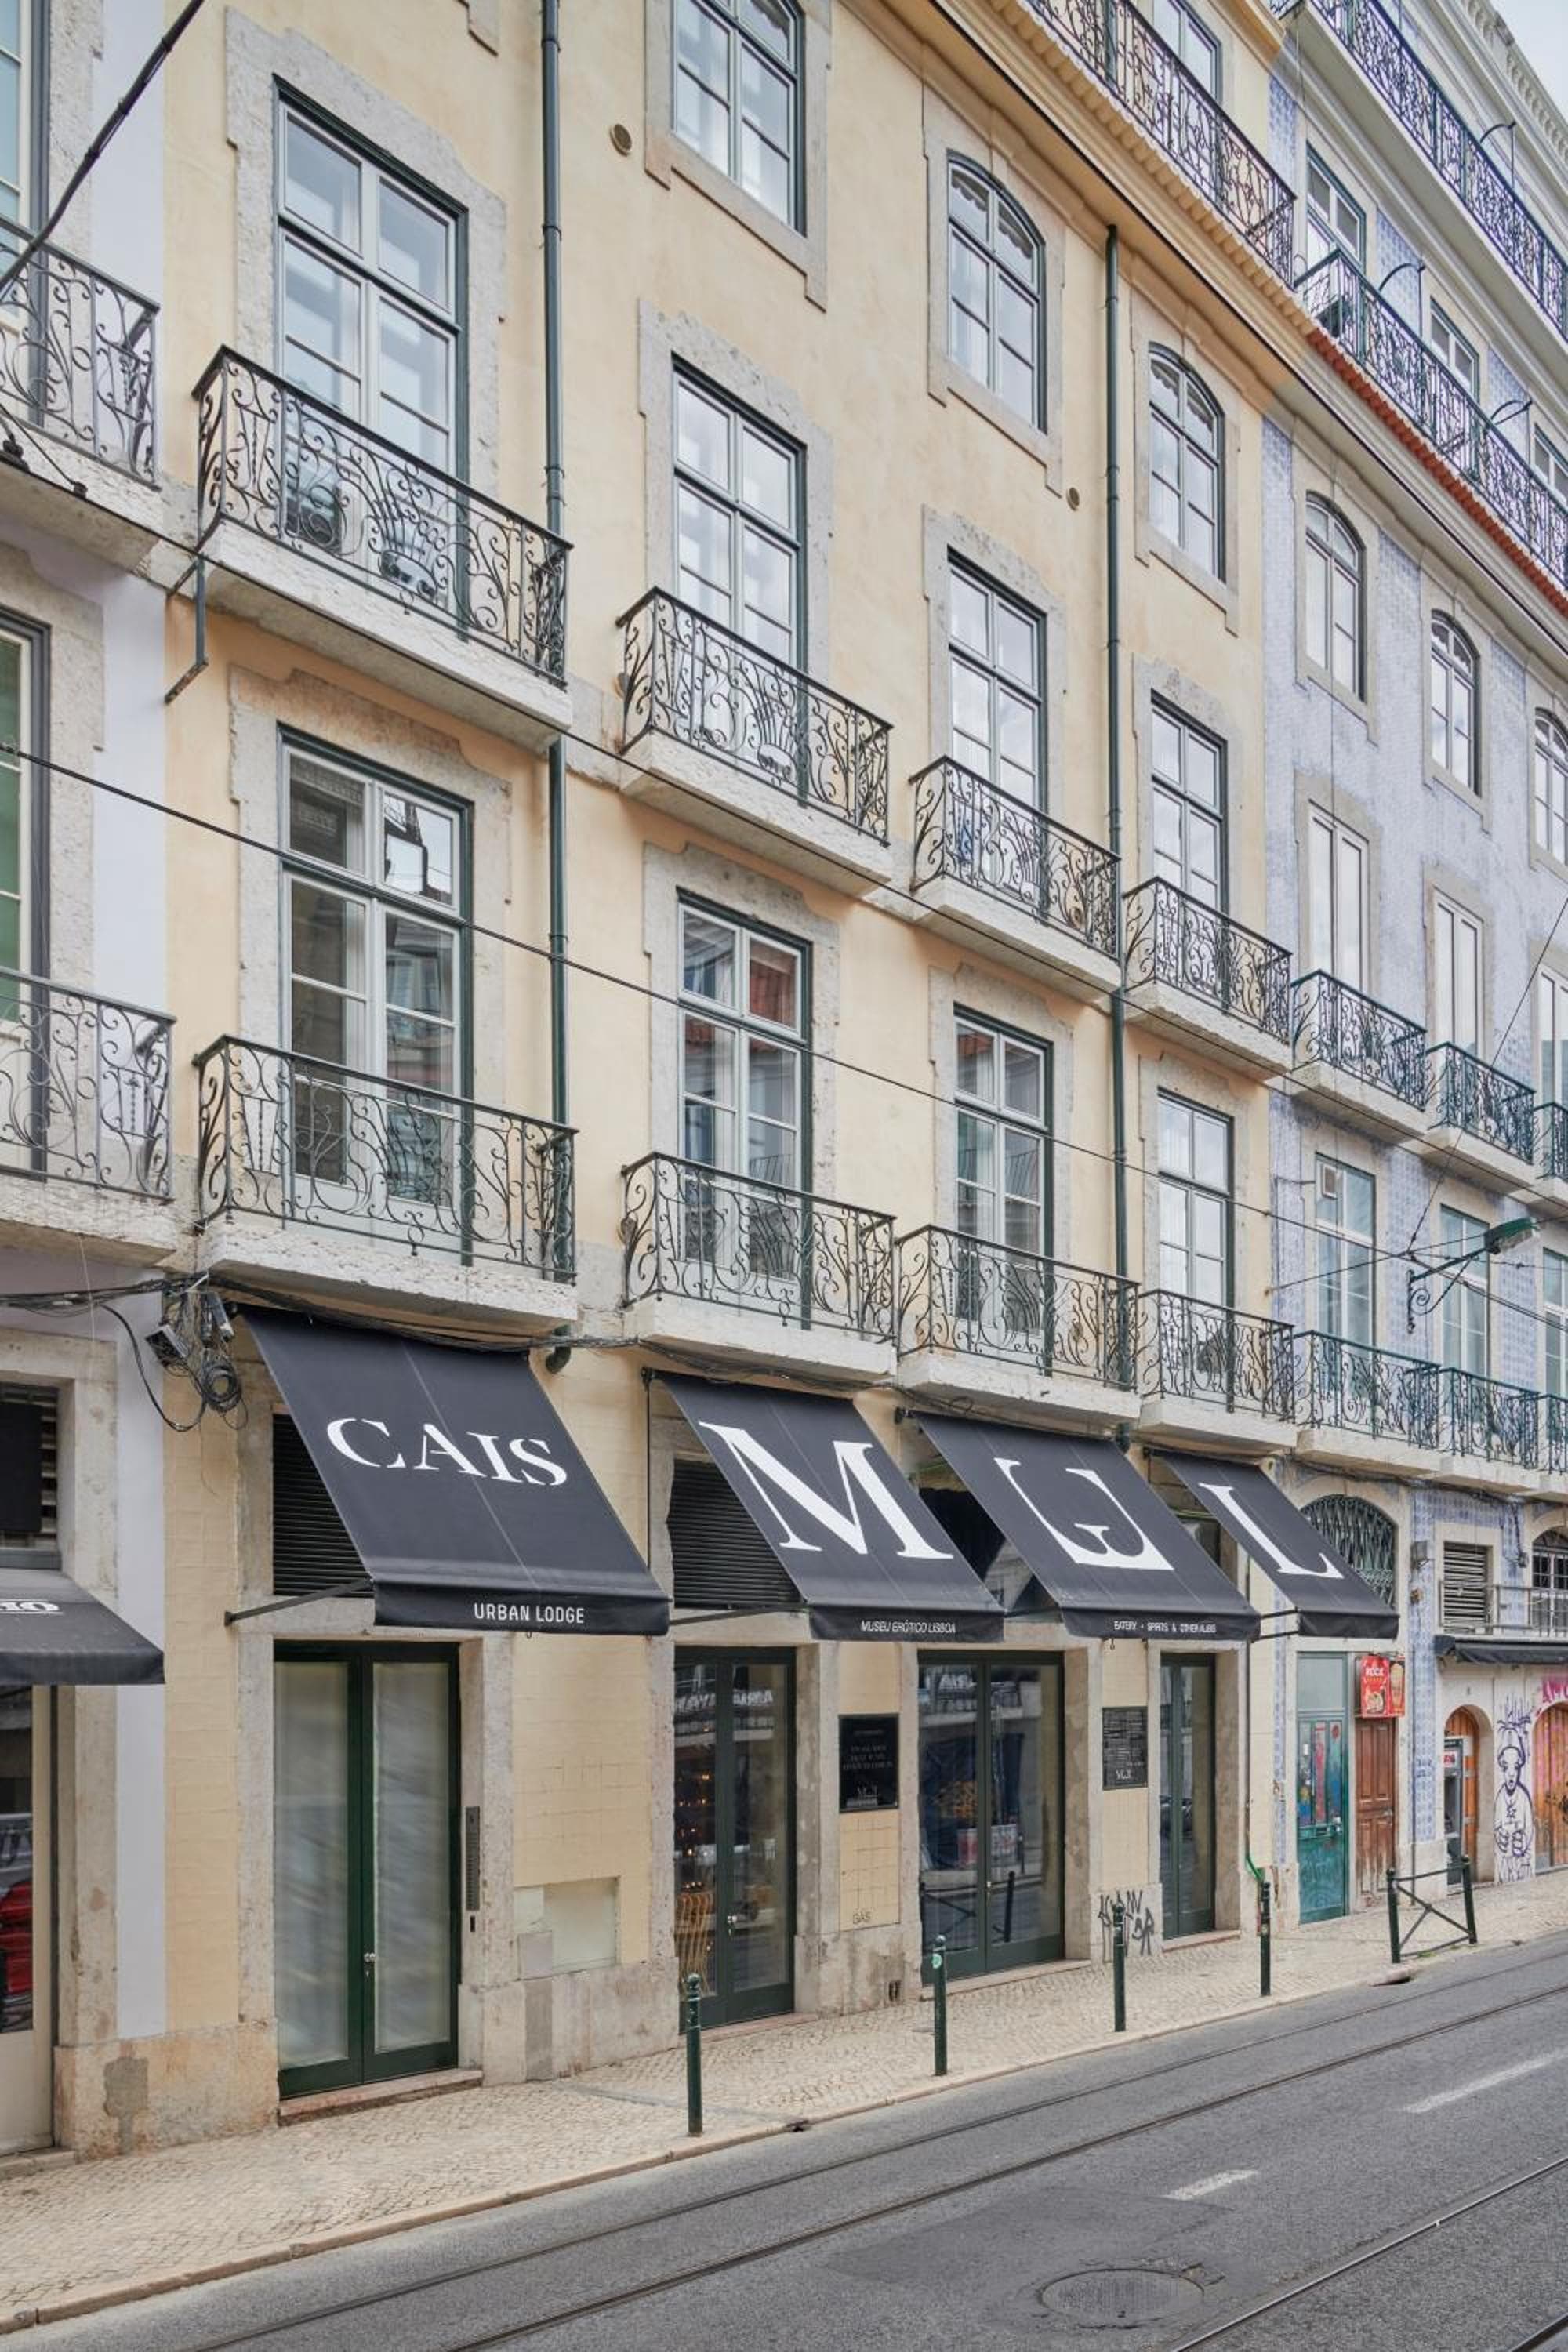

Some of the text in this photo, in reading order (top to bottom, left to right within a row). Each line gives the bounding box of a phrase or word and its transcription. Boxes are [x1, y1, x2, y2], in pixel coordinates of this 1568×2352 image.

[326, 1417, 568, 1487] CAIS
[698, 1420, 954, 1559] M
[1198, 1481, 1345, 1580] L
[474, 1602, 585, 1624] URBAN LODGE
[860, 1620, 891, 1632] MUSEU
[927, 1622, 956, 1634] LISBOA
[1113, 1621, 1138, 1631] EATERY
